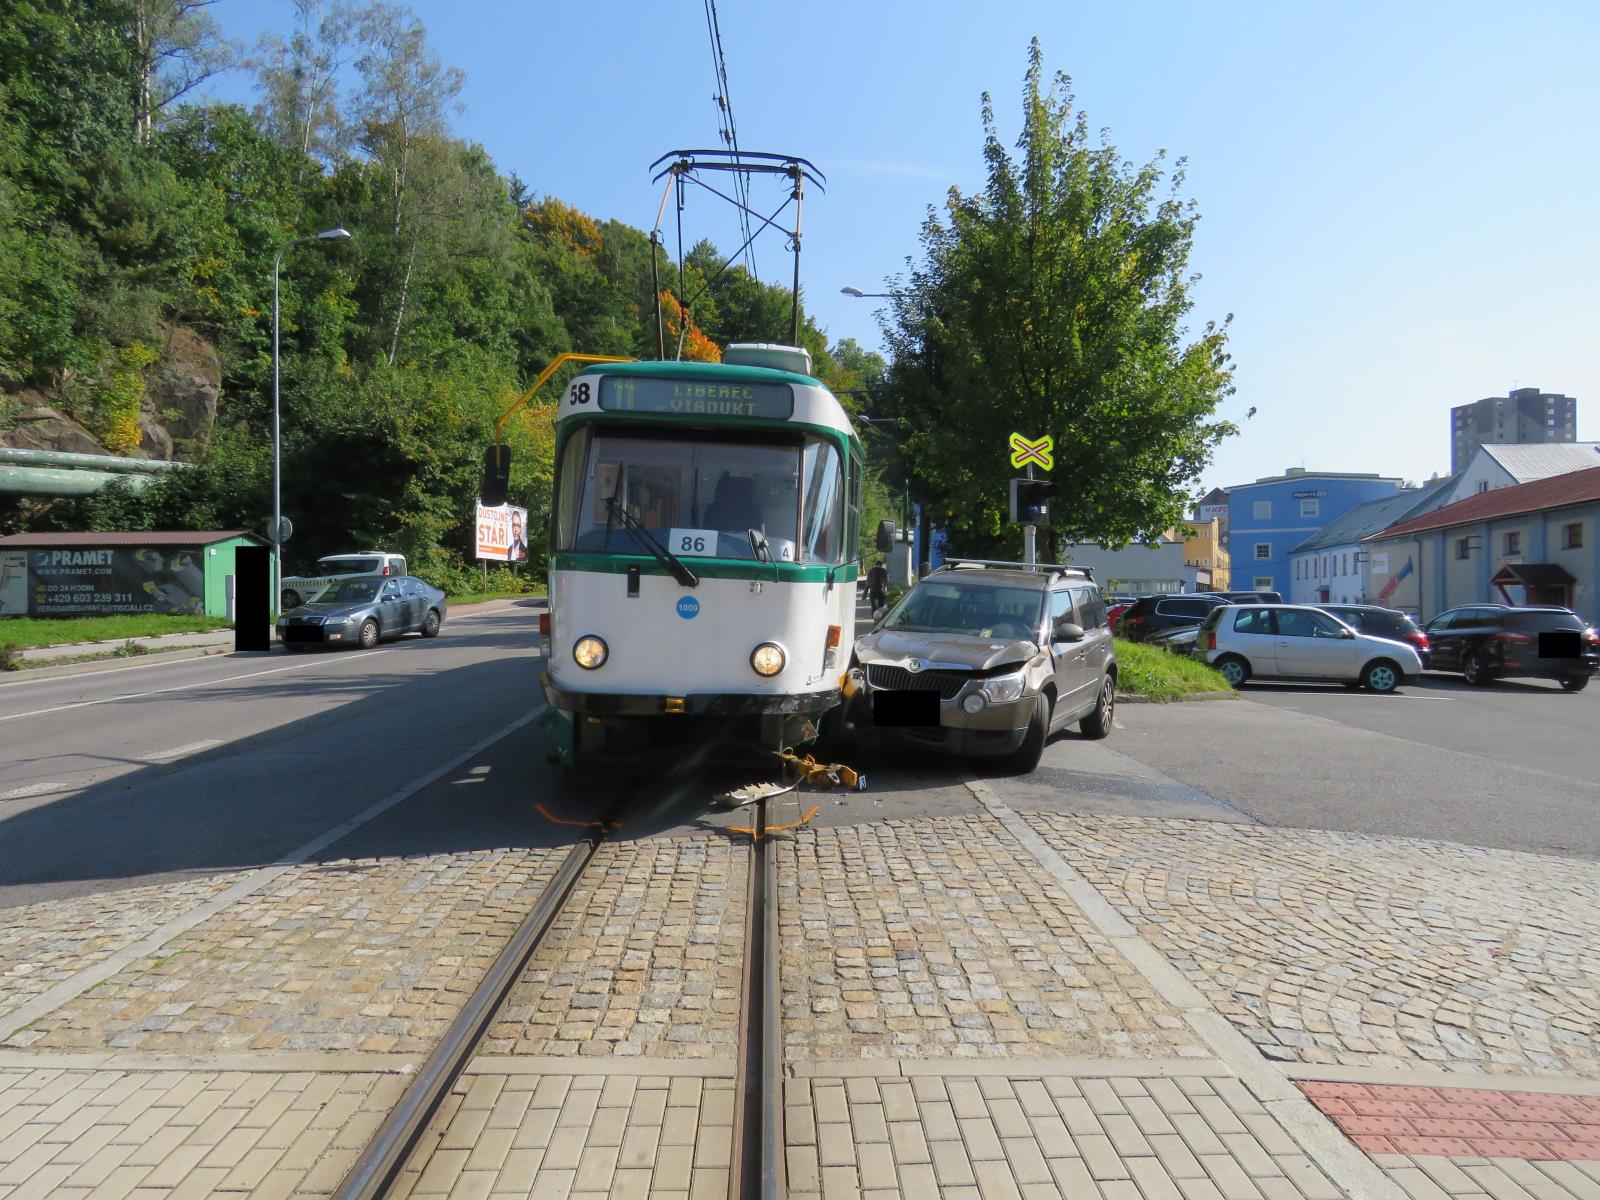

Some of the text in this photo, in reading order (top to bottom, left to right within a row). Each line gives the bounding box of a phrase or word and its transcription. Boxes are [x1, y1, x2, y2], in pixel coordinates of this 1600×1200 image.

[570, 382, 590, 406] 58
[613, 379, 634, 410] 11
[673, 383, 753, 399] LIBEREC
[671, 399, 756, 416] VIADUKT
[681, 536, 705, 552] 86
[51, 549, 114, 566] PRAMET
[36, 567, 113, 576] WWW.PRAMET.COM
[679, 603, 698, 612] 1000
